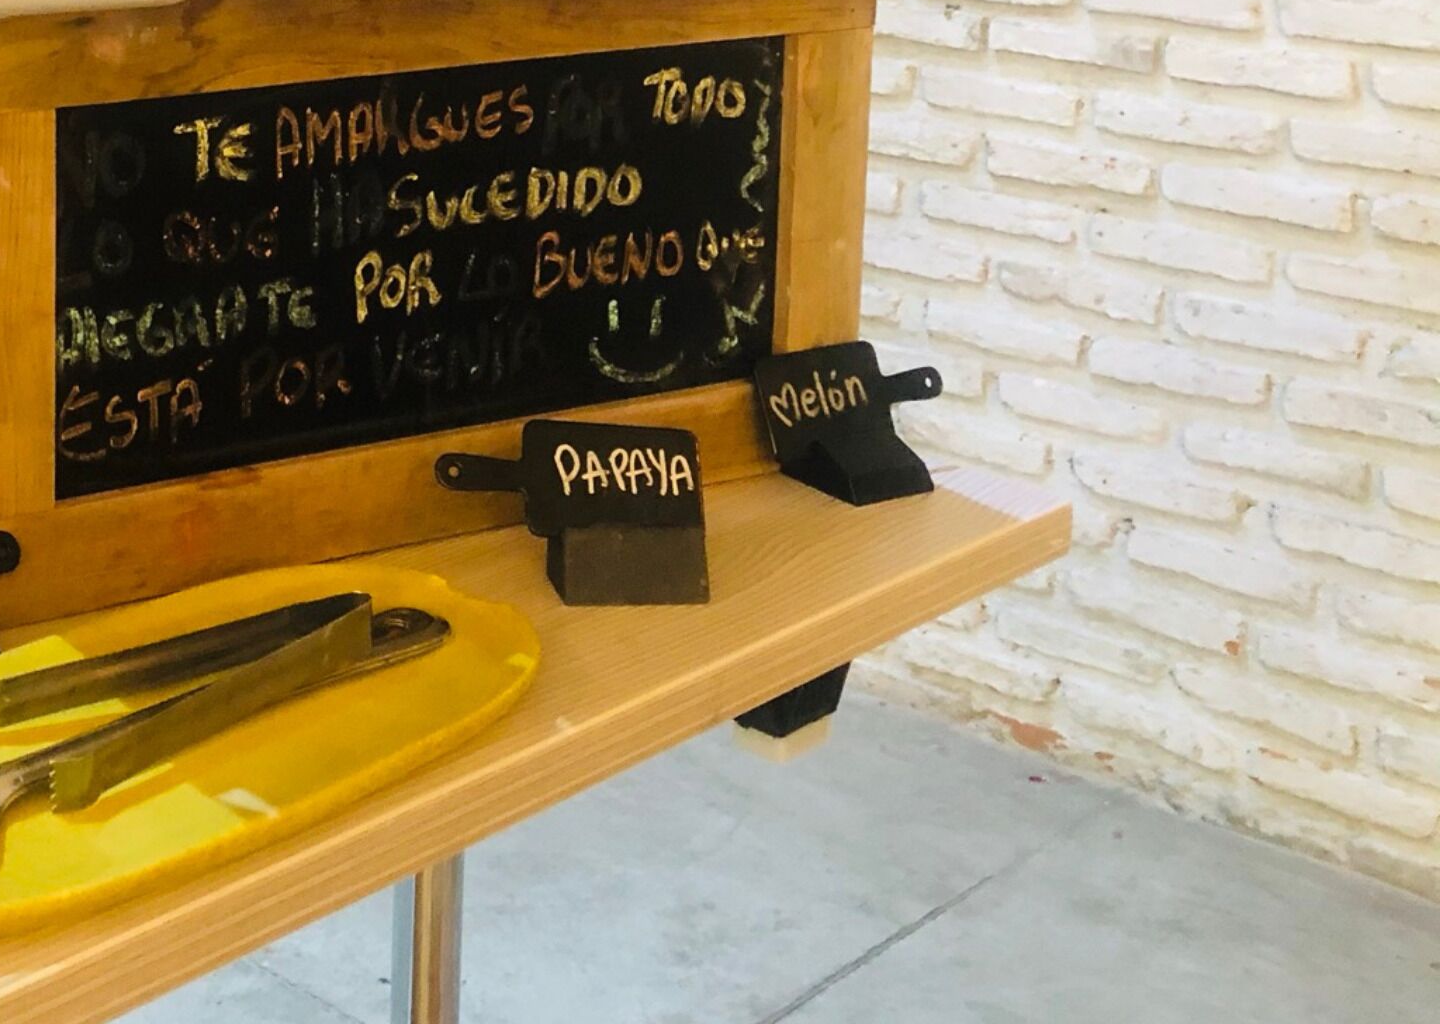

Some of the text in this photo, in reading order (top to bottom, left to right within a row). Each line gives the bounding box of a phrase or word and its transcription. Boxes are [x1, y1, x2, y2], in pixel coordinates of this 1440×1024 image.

[171, 114, 254, 183] TE
[643, 66, 748, 127] TODO
[387, 163, 644, 239] SUCEDIDO
[353, 248, 443, 325] POR
[530, 228, 685, 301] BUENO
[768, 367, 868, 429] Melón
[553, 442, 695, 497] PAPAYA
